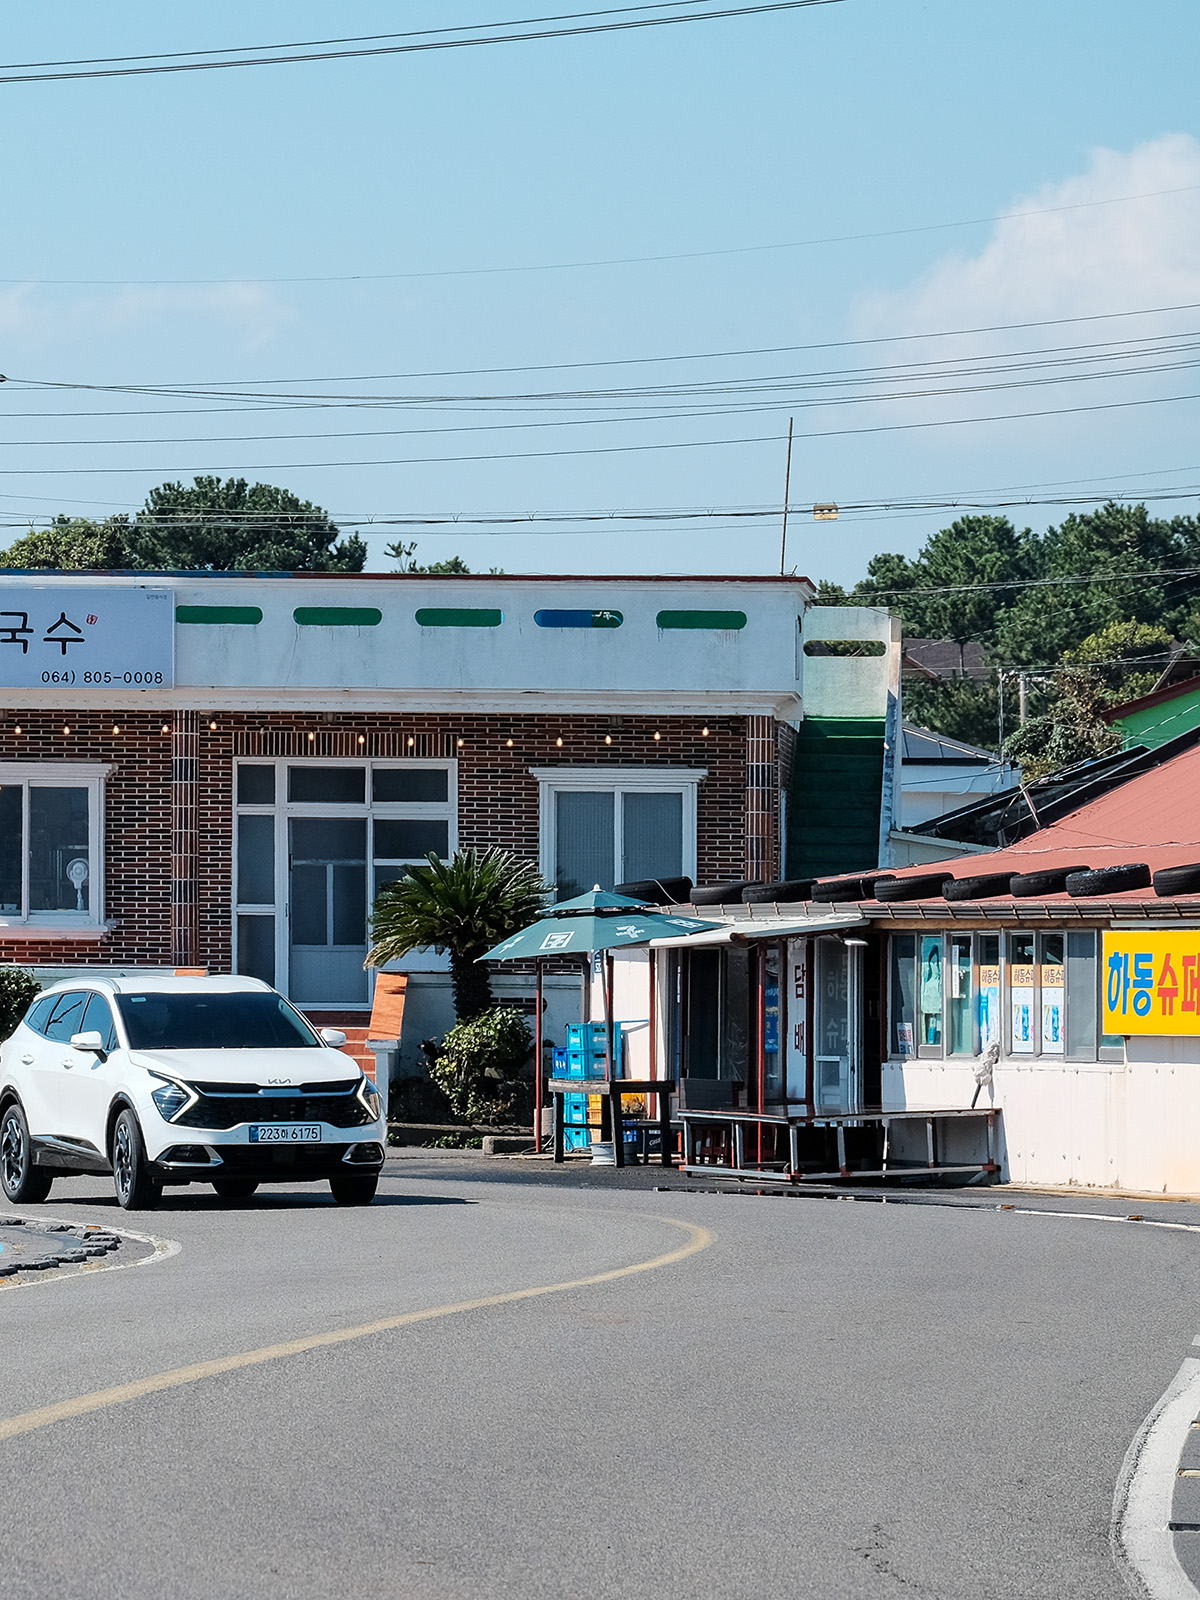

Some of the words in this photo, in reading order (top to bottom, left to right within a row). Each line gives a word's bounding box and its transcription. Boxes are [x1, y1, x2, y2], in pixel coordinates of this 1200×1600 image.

[41, 670, 75, 684] 064)
[83, 671, 163, 684] 805-0008
[1107, 952, 1200, 1017] 하동슈퍼
[291, 1128, 318, 1139] 6175
